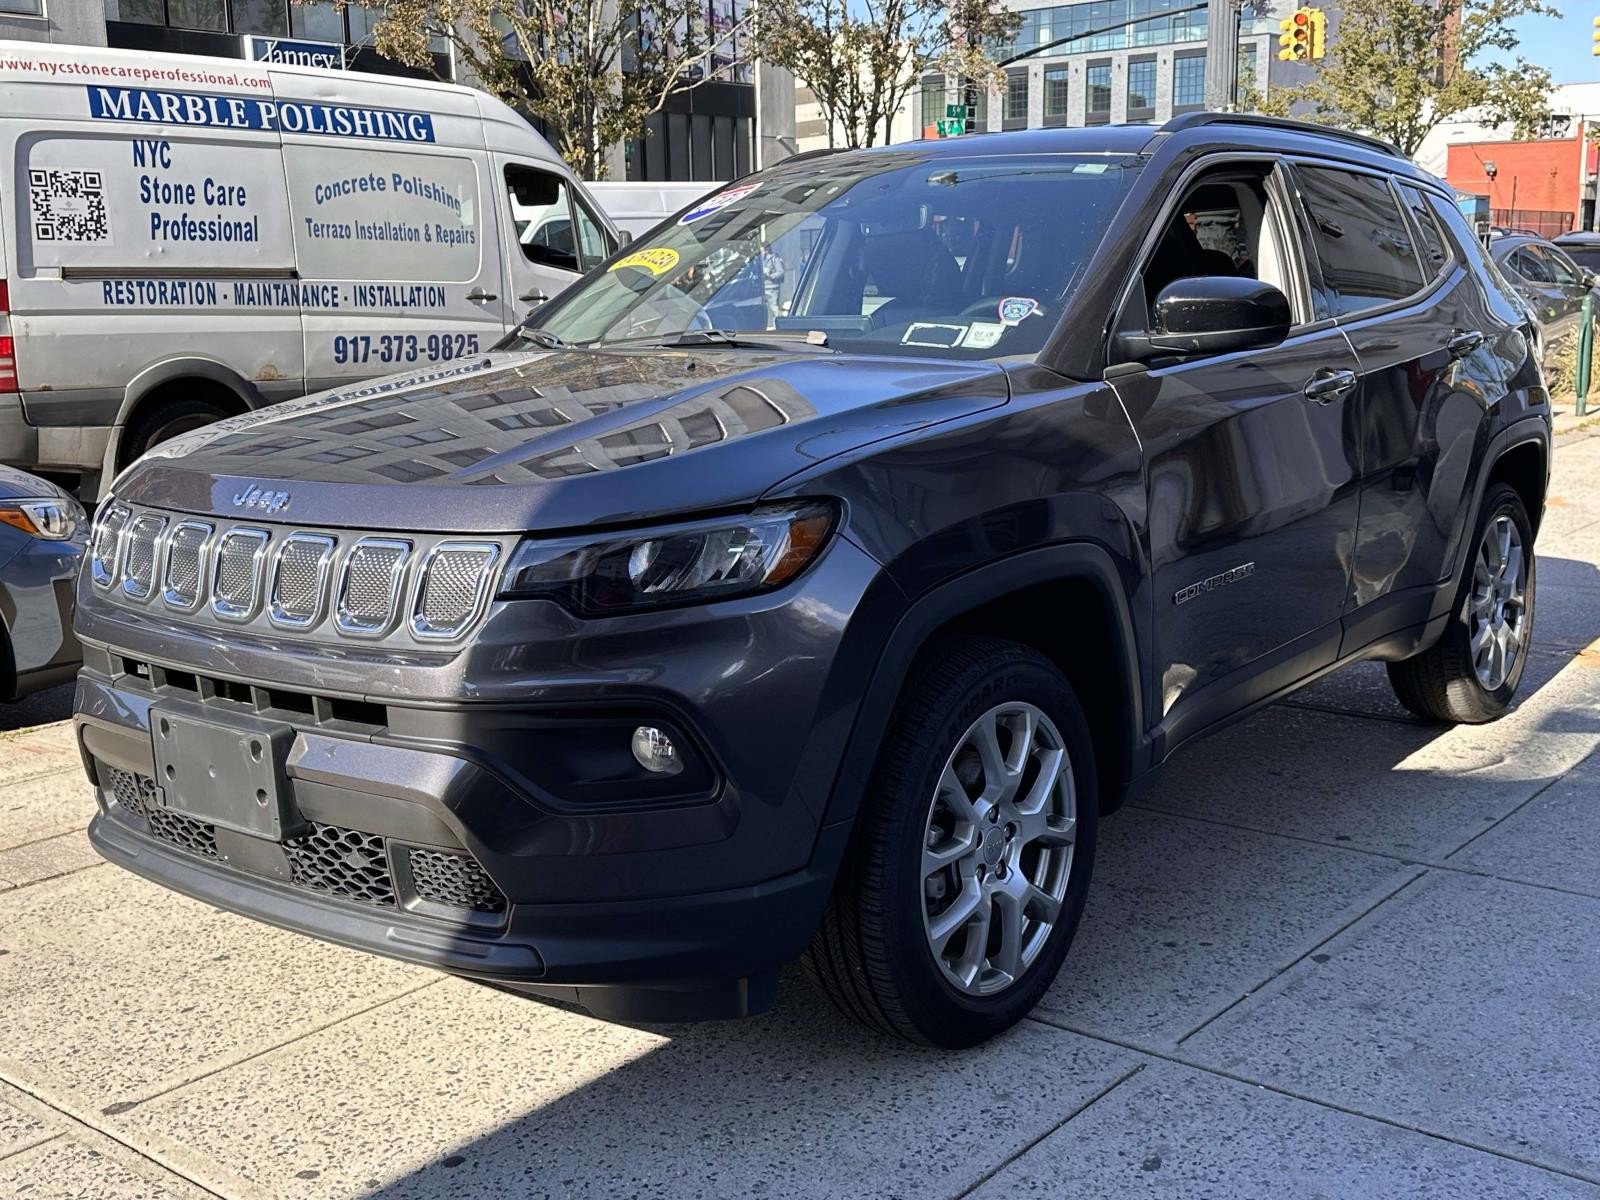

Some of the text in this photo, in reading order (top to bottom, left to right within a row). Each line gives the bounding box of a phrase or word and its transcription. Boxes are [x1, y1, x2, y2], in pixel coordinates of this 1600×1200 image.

[97, 88, 427, 141] MARBLE POLISHING
[133, 139, 171, 168] NYC
[140, 174, 247, 206] Stone Care
[315, 172, 462, 216] Concrete Polishing
[151, 212, 259, 242] Professional
[305, 217, 475, 248] Terrazo Installation & Repairs
[103, 280, 446, 307] RESTORATION MAINTANANCE INSTALLATION
[334, 334, 478, 364] 917-373-9825
[232, 484, 290, 513] Jeep
[1174, 562, 1255, 605] COMPASS
